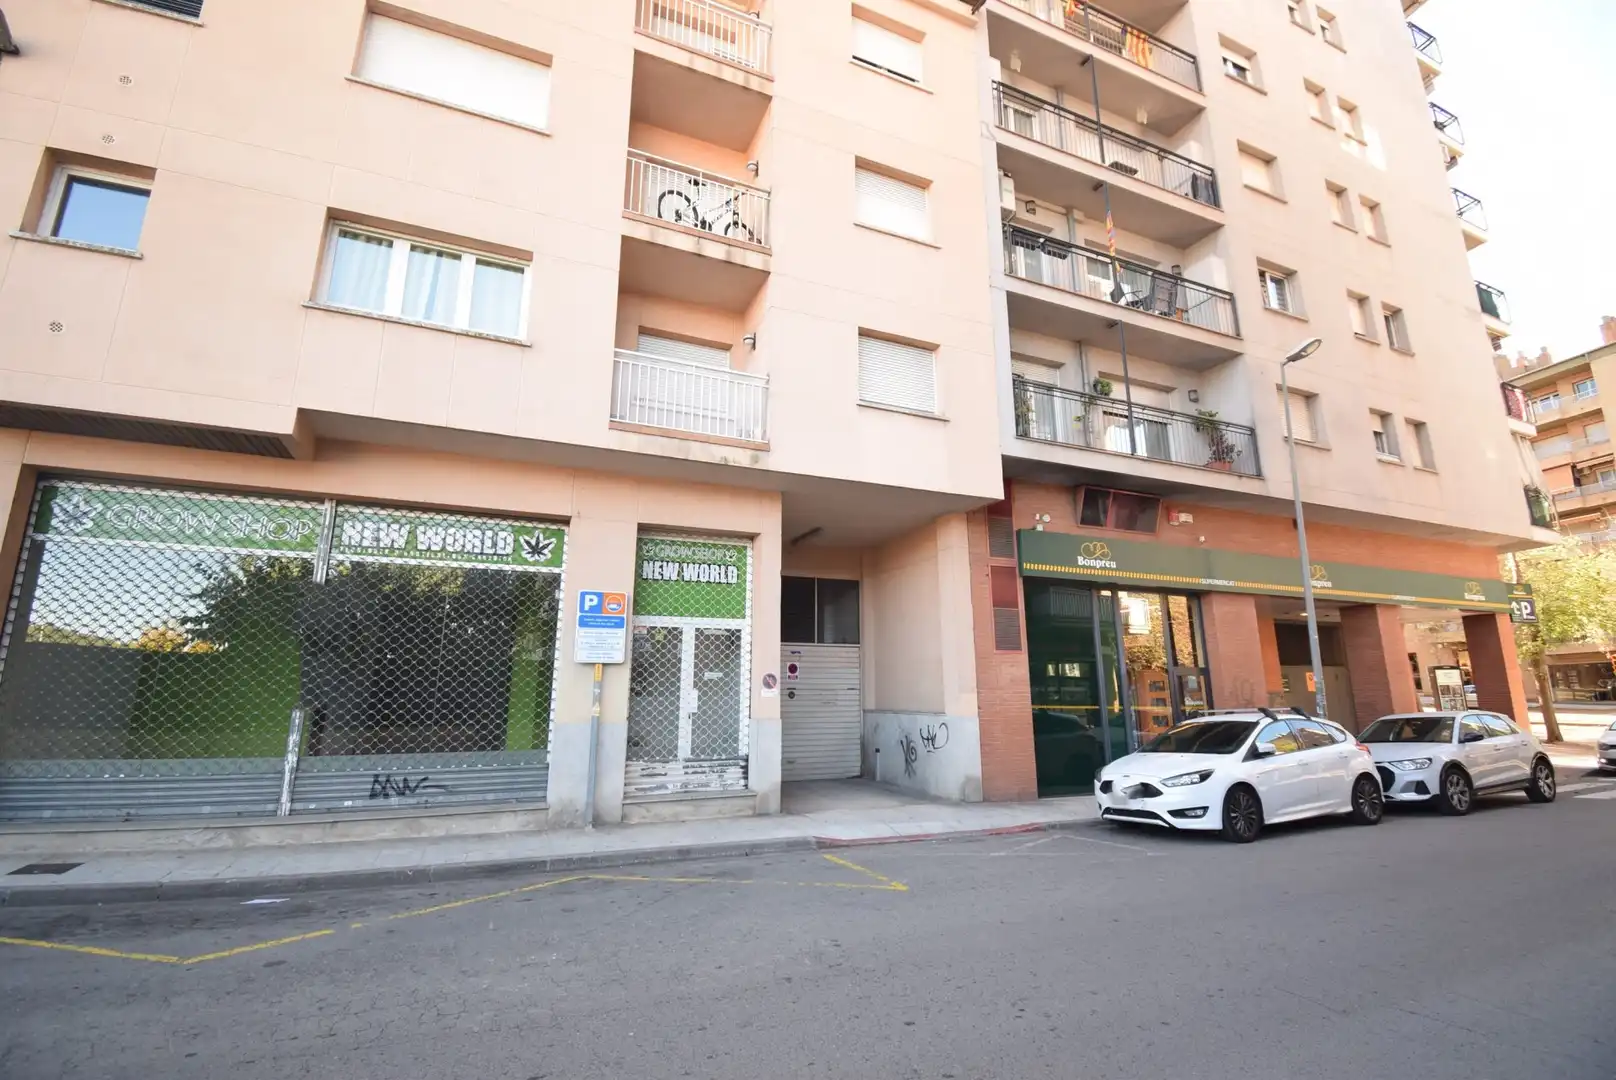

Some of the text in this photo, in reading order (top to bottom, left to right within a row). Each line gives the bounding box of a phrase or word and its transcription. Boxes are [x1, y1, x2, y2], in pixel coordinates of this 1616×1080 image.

[107, 504, 313, 542] GROW SHOP
[341, 520, 516, 556] NEW WORLD
[642, 559, 738, 584] NEW WORLD
[1077, 555, 1117, 569] Bonpreu
[584, 594, 598, 611] P
[1520, 601, 1532, 620] P
